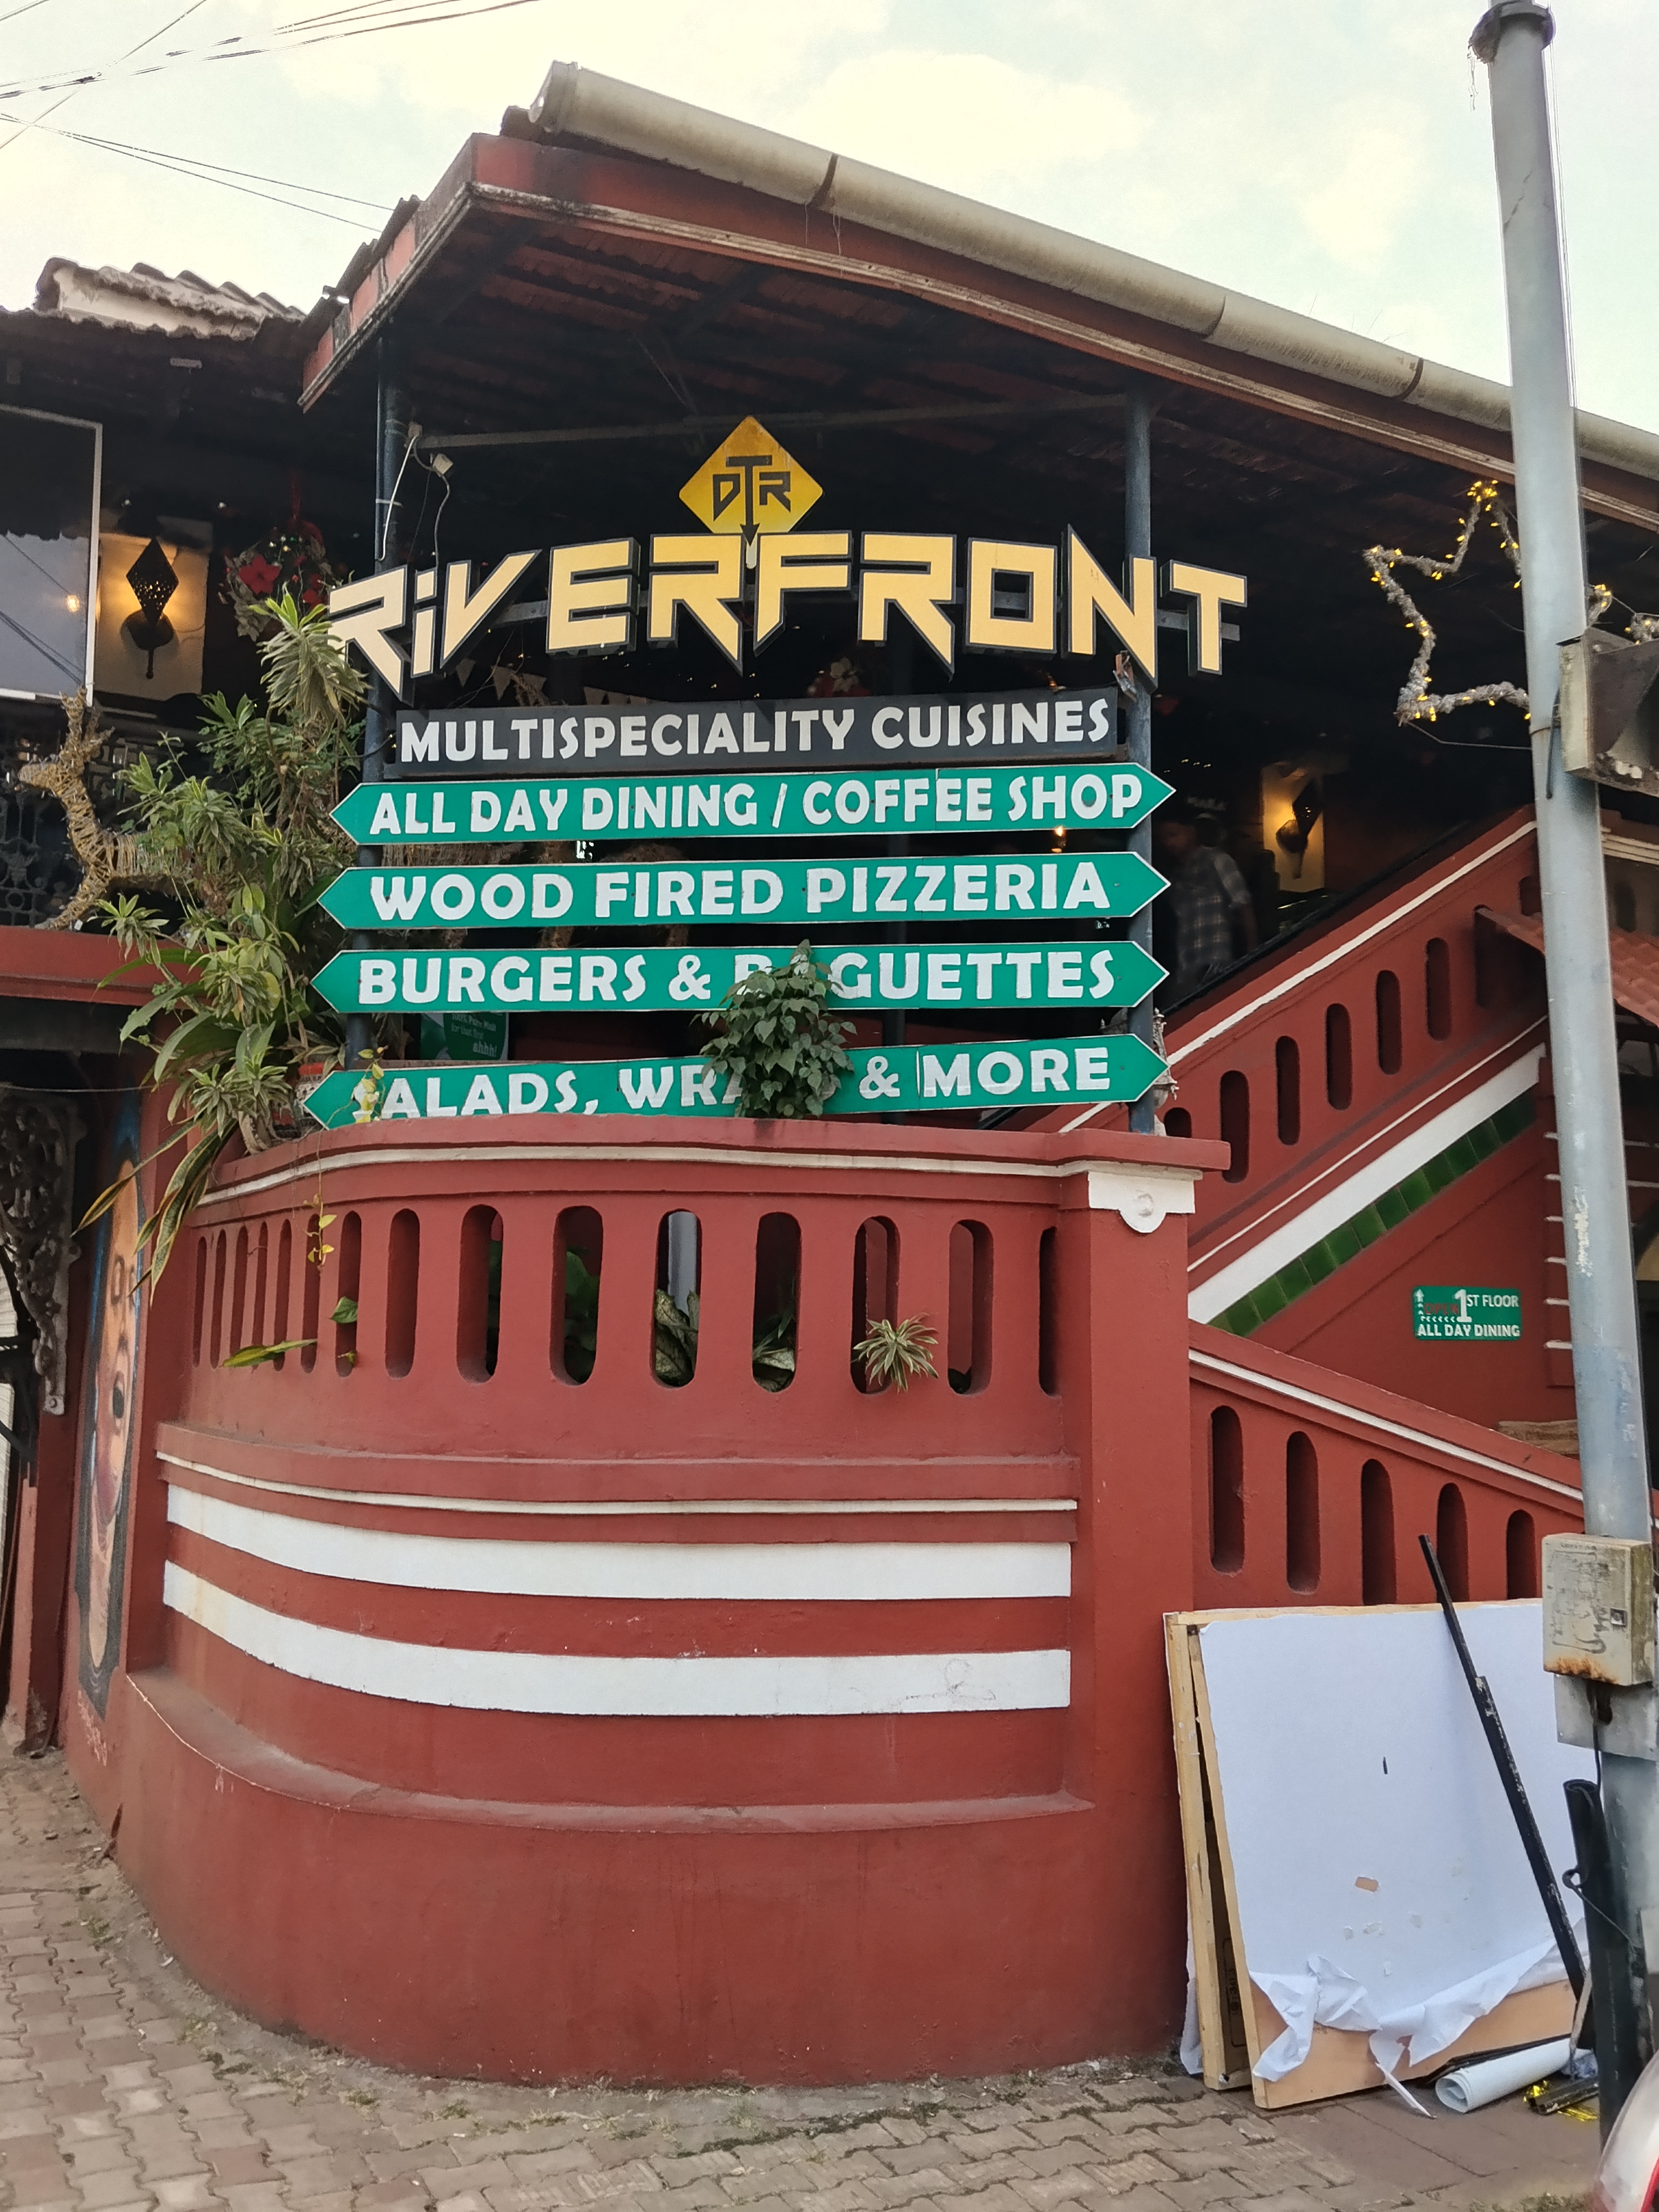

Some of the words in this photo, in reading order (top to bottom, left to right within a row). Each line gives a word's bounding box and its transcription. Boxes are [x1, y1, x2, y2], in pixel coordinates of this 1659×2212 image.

[712, 455, 791, 547] DTR
[401, 709, 855, 763] MULTISPECIALITY
[872, 699, 1110, 749] CUISINES
[369, 792, 455, 834] ALL
[470, 789, 568, 832] DAY
[582, 784, 757, 830] DINING
[772, 783, 787, 828] /
[802, 778, 992, 825] COFFEE
[1008, 774, 1142, 821] SHOP
[370, 874, 573, 921] WOOD
[595, 870, 783, 918] FIRED
[807, 862, 1110, 913] PIZZERIA
[359, 955, 646, 1004] BURGERS
[668, 955, 711, 1001] &
[734, 950, 1114, 1000] BGUETTES
[859, 1056, 900, 1100] &
[922, 1047, 1110, 1098] MORE
[1417, 1324, 1442, 1337] ALL
[1445, 1324, 1471, 1337] DAY
[1474, 1324, 1520, 1337] DINING
[1424, 1303, 1459, 1315] OPEN
[1454, 1289, 1480, 1323] 1ST
[1482, 1294, 1519, 1307] FLOOR
